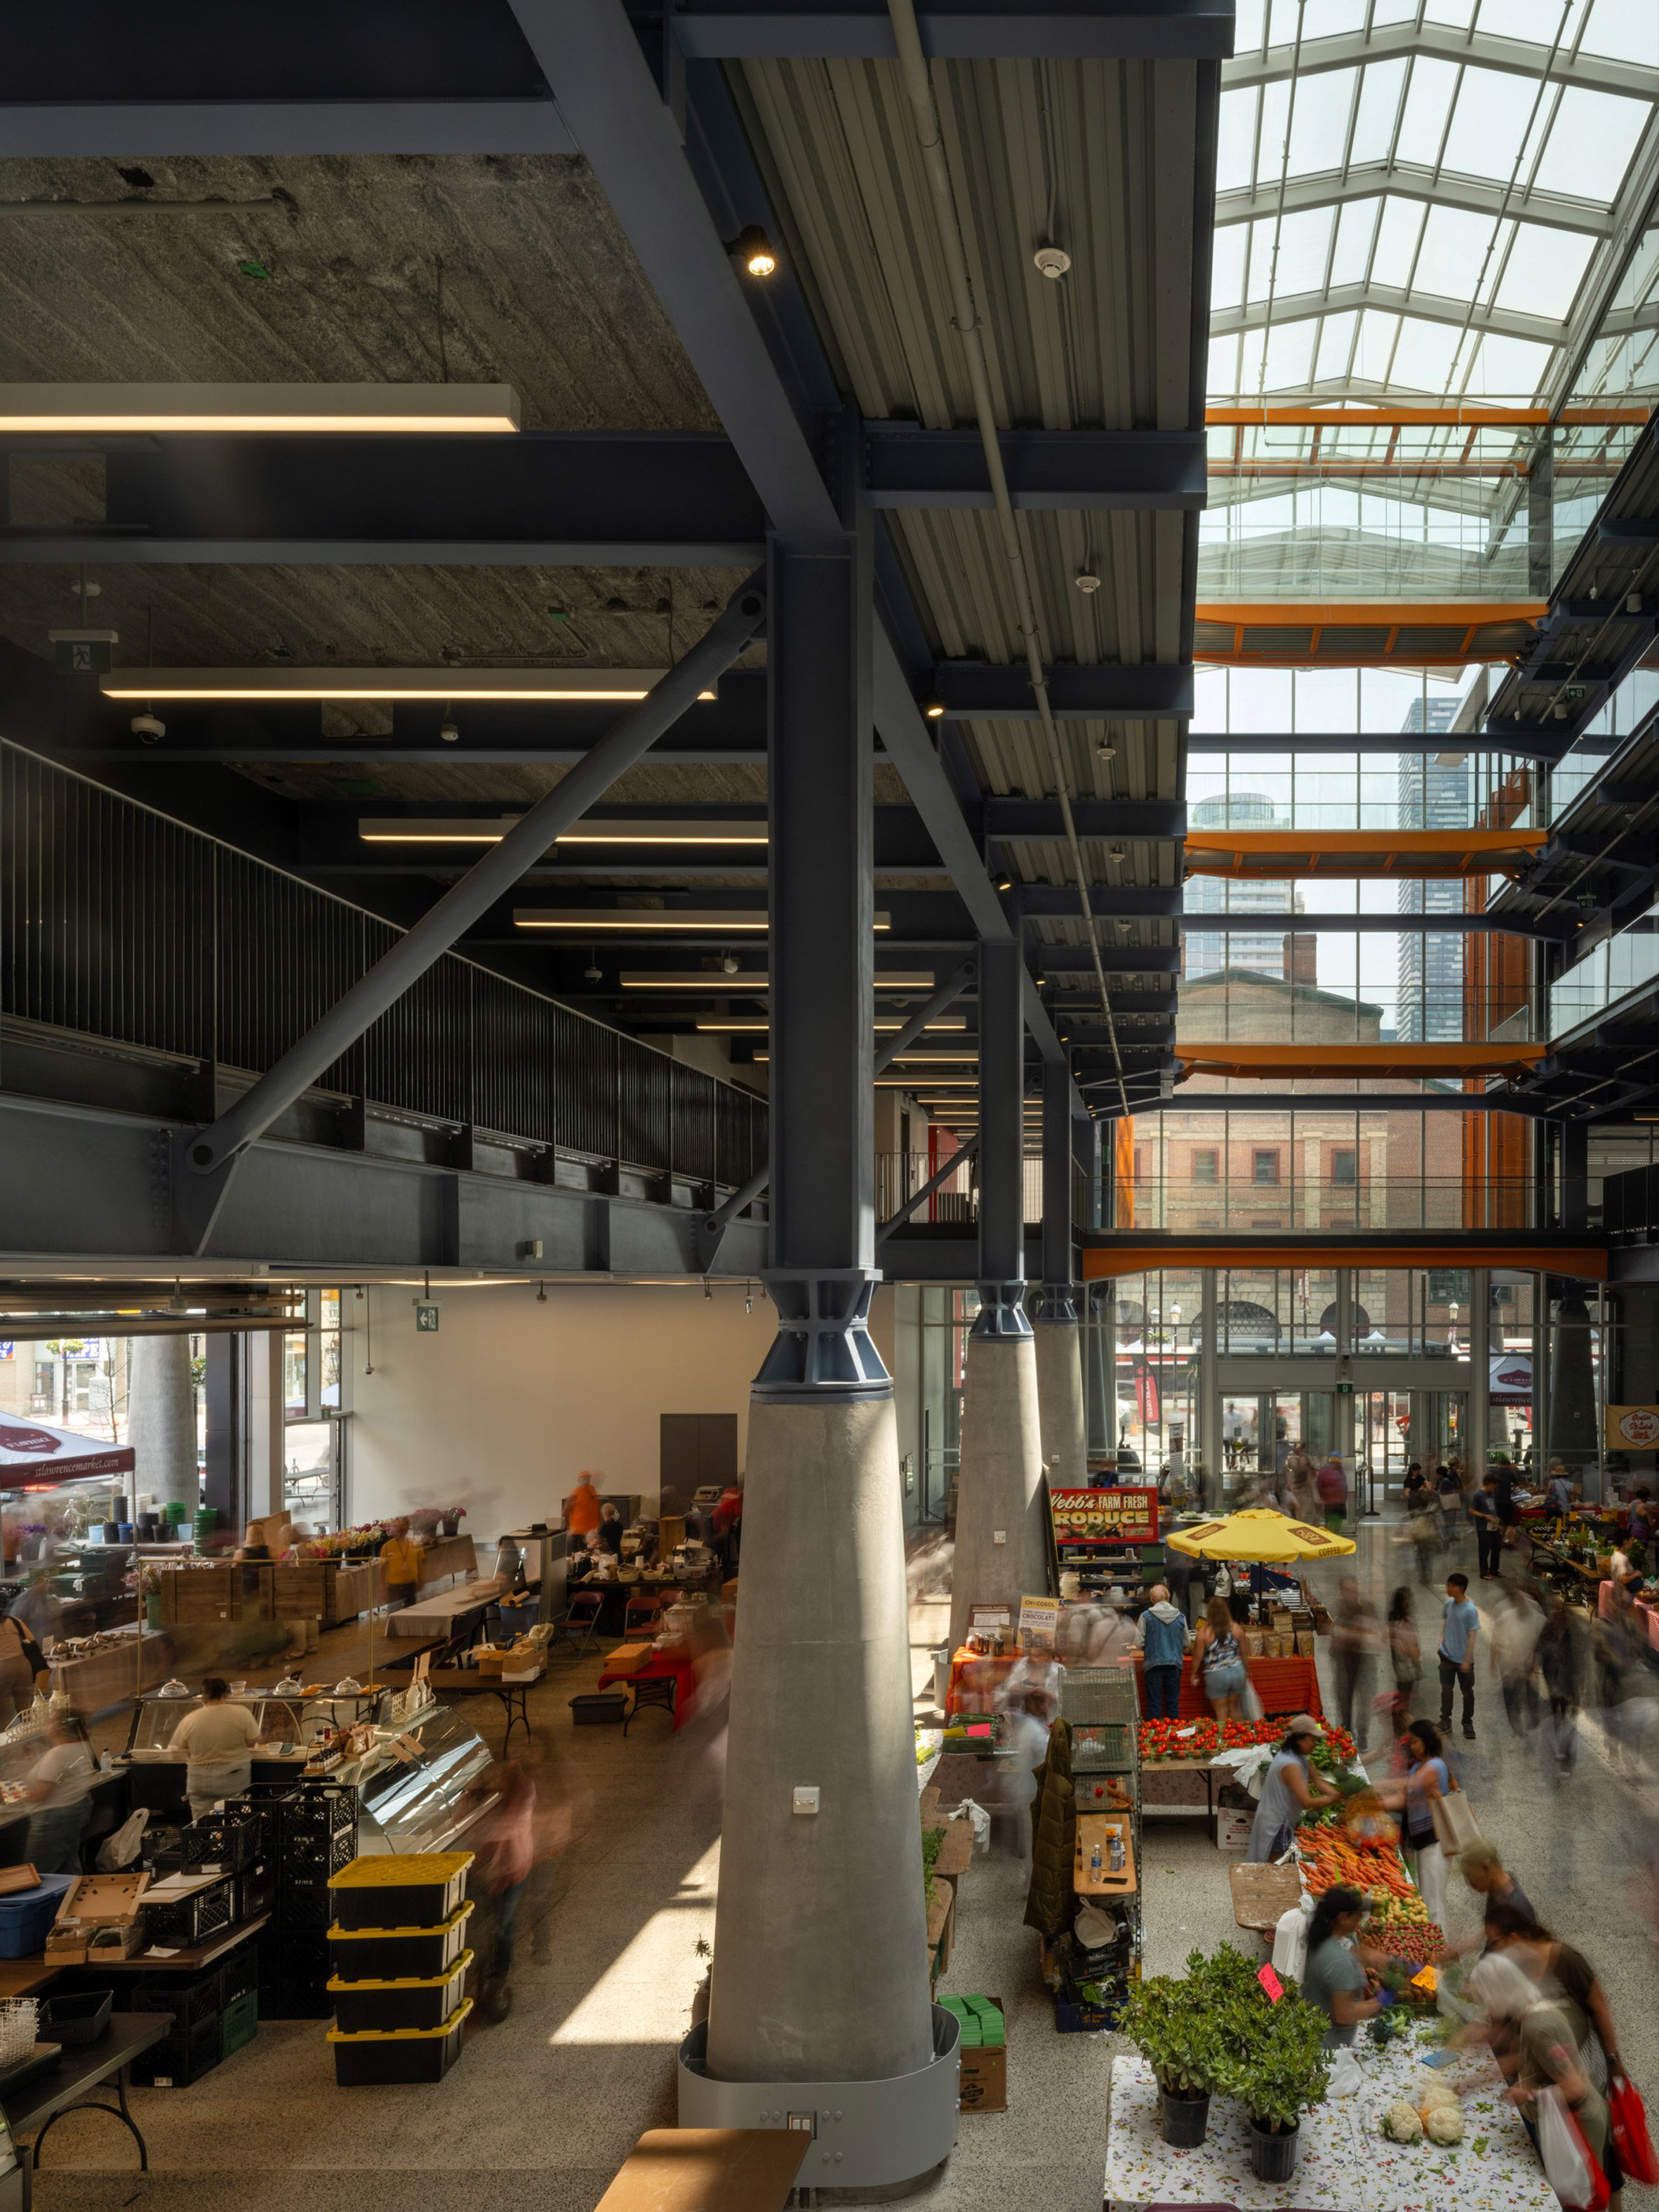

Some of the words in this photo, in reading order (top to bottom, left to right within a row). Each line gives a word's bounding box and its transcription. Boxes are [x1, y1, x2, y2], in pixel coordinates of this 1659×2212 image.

[13, 1437, 52, 1447] LAWRENCE
[34, 1457, 119, 1477] stlawrencemarket.com
[1098, 1496, 1121, 1509] FARM
[1124, 1495, 1147, 1509] FRESH
[1053, 1511, 1150, 1525] RODUCE
[1319, 1546, 1341, 1557] COFFEE
